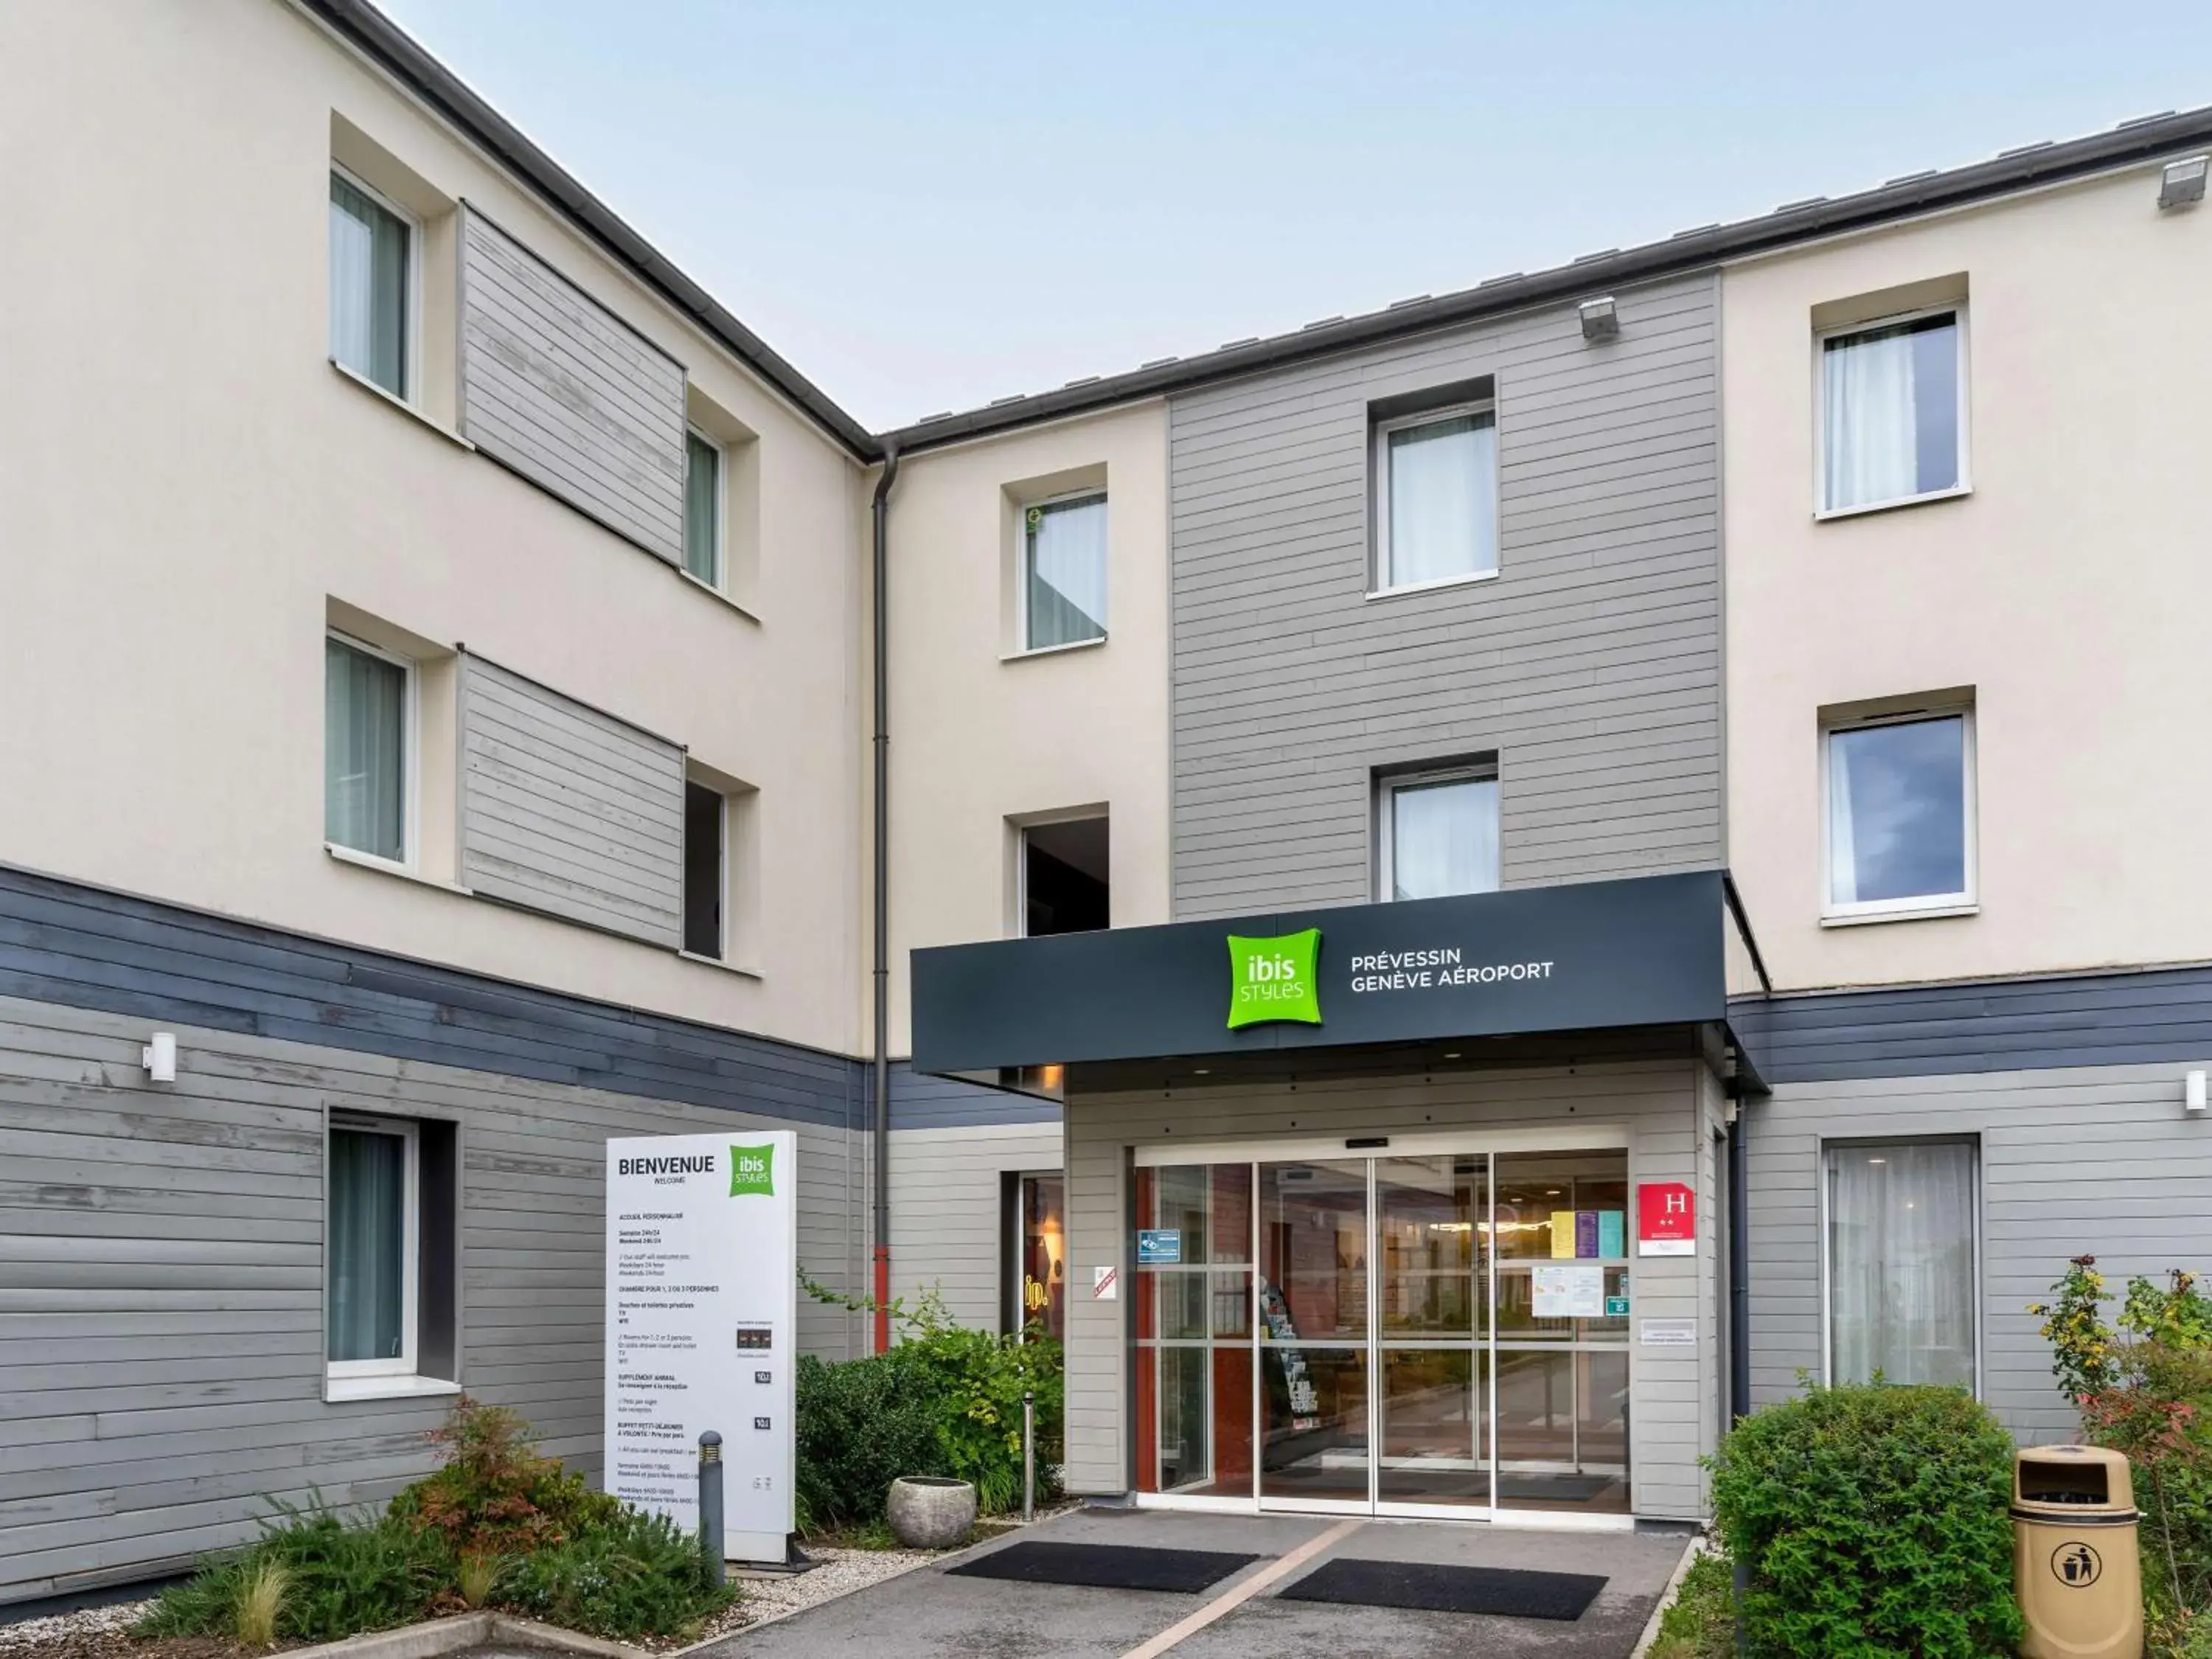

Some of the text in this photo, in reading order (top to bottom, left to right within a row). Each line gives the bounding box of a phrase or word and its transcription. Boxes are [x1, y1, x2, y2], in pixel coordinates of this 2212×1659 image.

[1248, 953, 1295, 982] ibis
[1351, 948, 1461, 973] PRÉVESSIN
[1352, 961, 1554, 992] GENÈVE AÉROPORT
[619, 1155, 714, 1175] BIENVENUE
[740, 1156, 765, 1172] ibis
[655, 1177, 686, 1185] WELCOME
[1665, 1193, 1687, 1213] H
